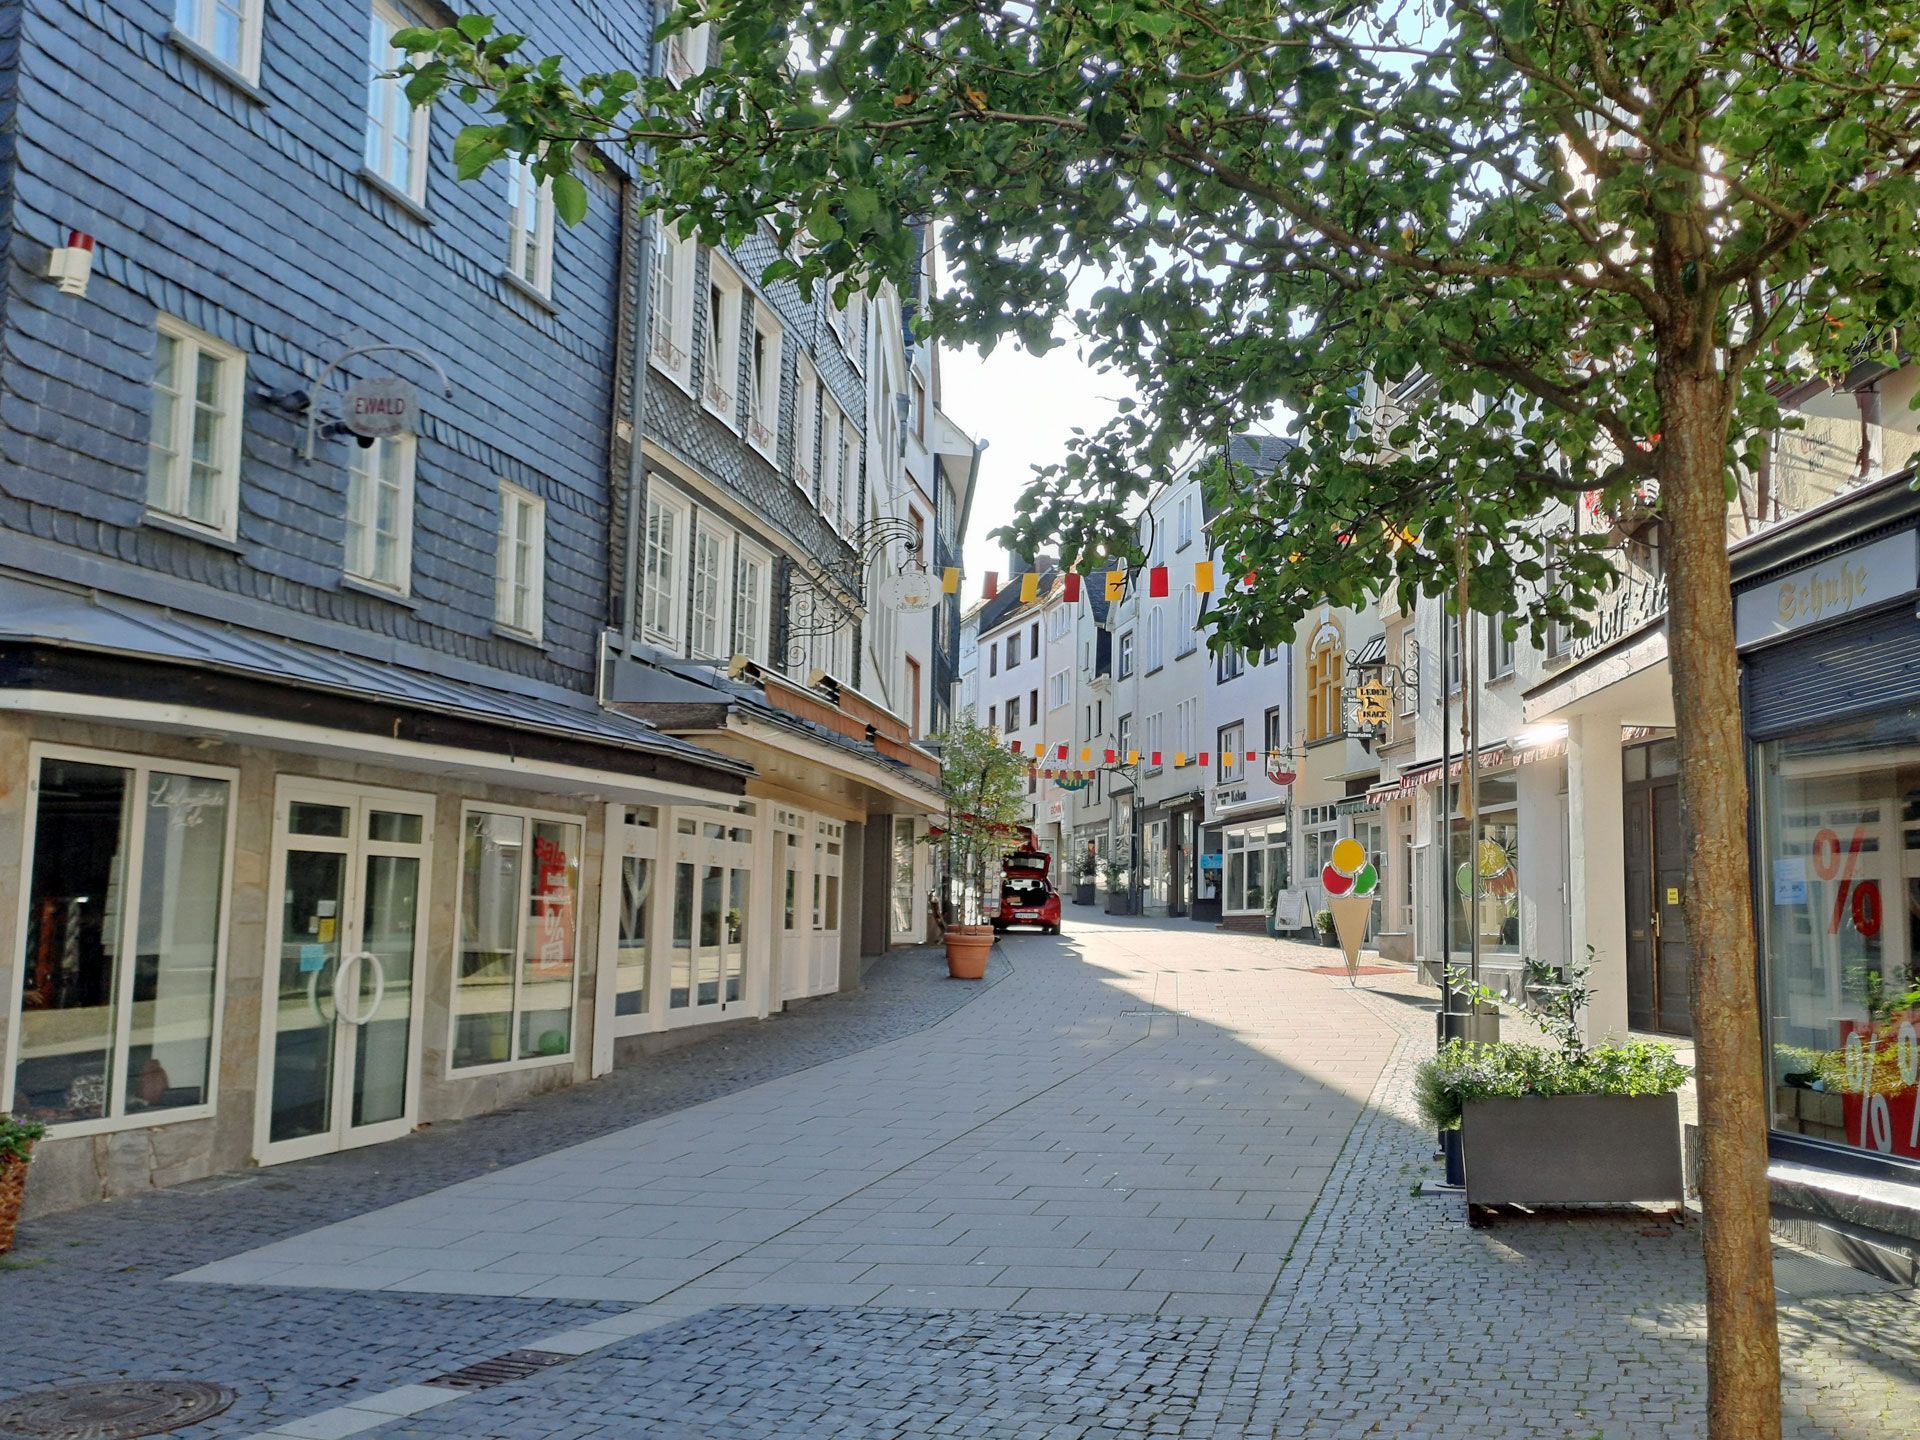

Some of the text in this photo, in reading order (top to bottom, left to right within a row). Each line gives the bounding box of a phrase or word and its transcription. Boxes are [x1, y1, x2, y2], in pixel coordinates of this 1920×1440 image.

[355, 398, 405, 415] EWALD
[1777, 561, 1867, 621] Schuhe
[1360, 688, 1388, 696] LEDER
[1363, 710, 1387, 718] ISACK
